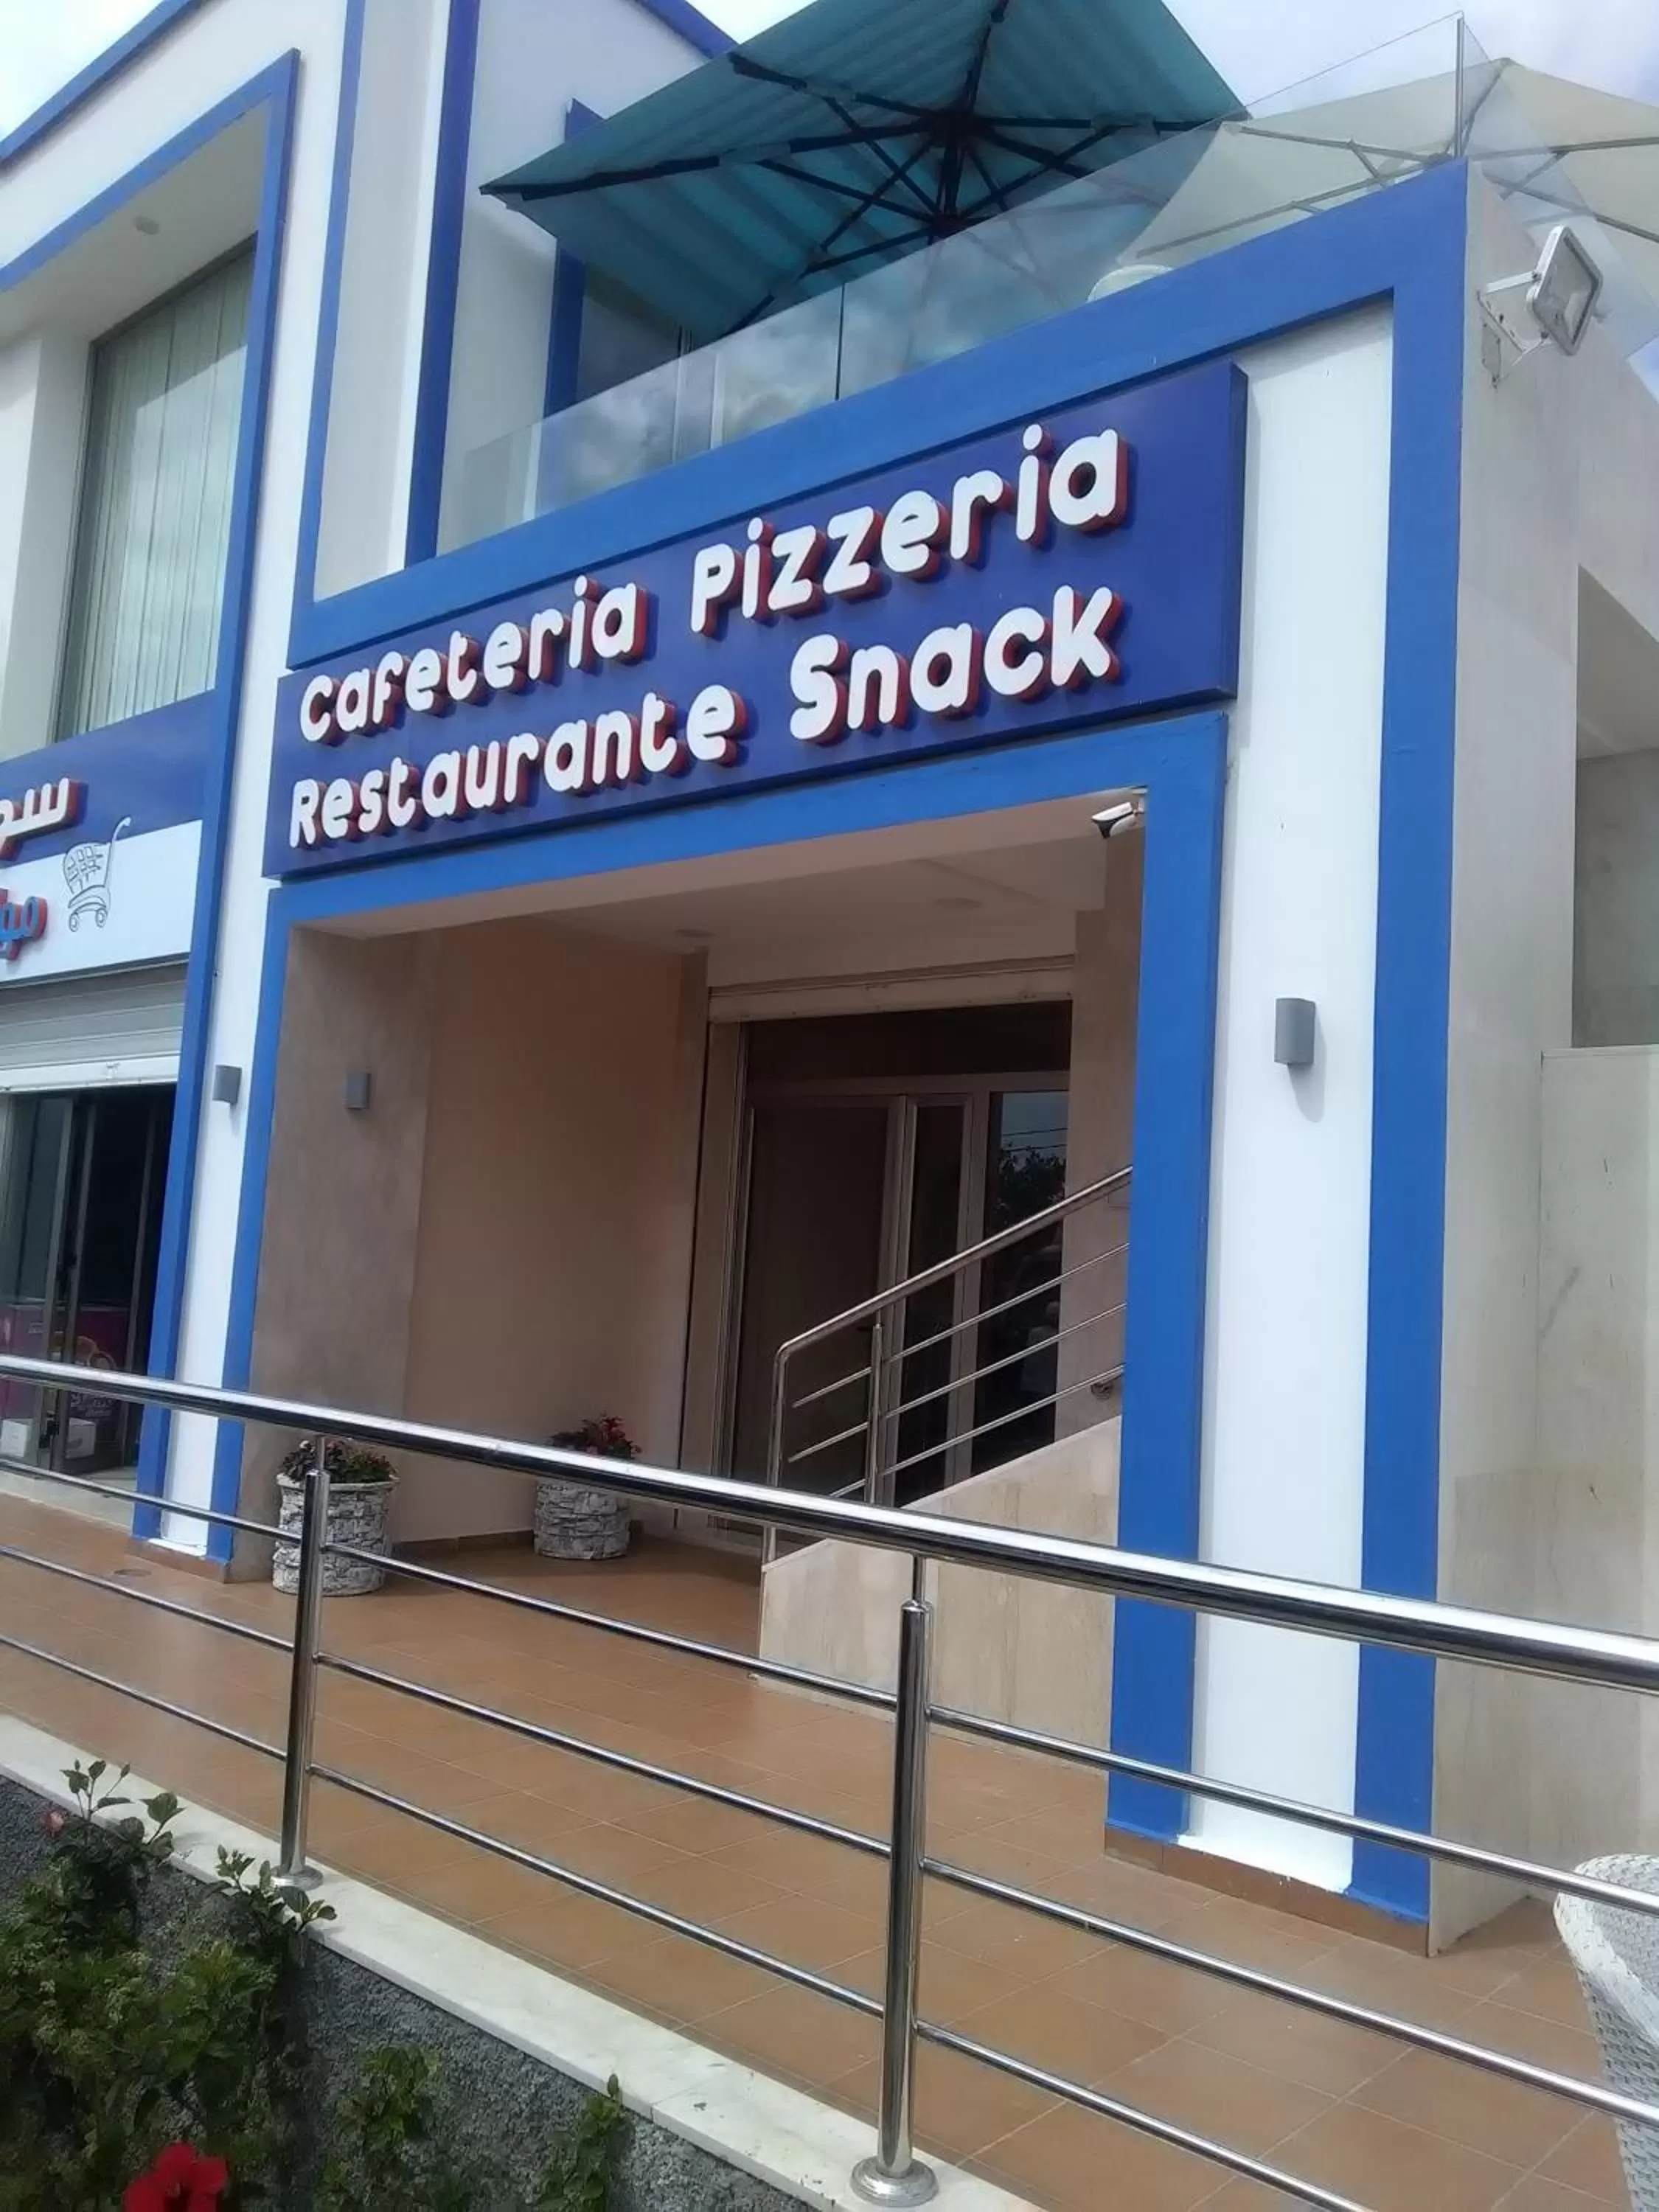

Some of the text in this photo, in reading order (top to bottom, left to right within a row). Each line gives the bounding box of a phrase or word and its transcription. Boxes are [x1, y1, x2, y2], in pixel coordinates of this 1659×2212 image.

[299, 423, 1124, 742] Cafeteria Pizzeria
[289, 684, 740, 848] Restaurante
